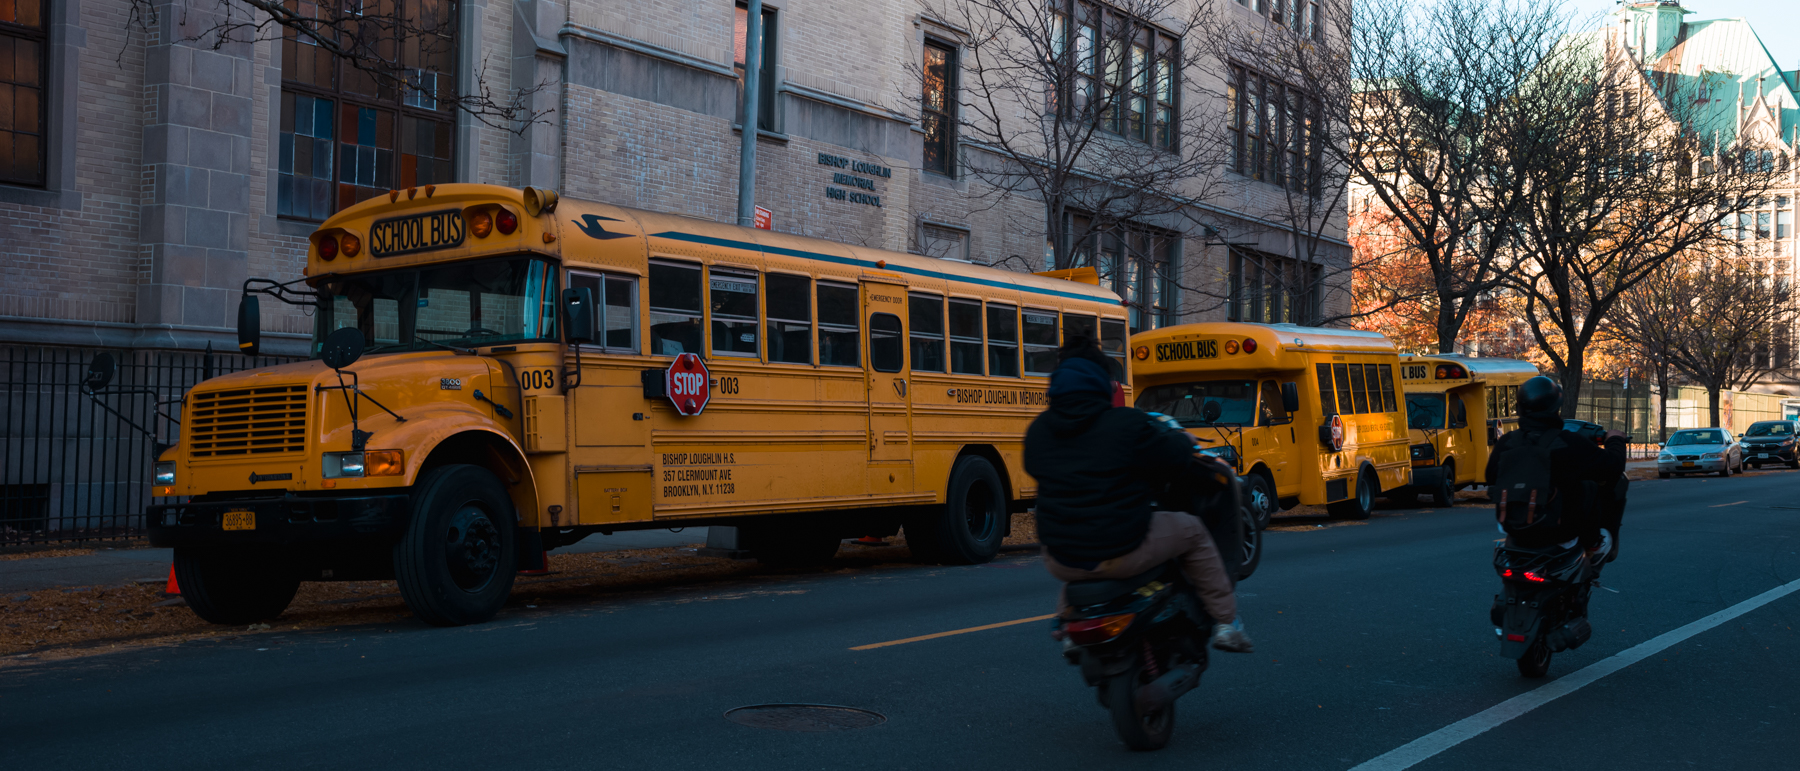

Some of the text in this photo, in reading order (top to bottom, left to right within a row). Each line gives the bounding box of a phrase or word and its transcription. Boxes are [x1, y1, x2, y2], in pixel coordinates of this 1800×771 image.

[818, 153, 891, 178] BISHOP LOUGHLIN
[834, 173, 876, 191] MEMORIAL
[826, 187, 882, 208] HIGH SCHOOL
[374, 212, 460, 253] SCHOOL BUS
[871, 294, 902, 304] EMERGENCY DOOR
[1157, 340, 1216, 361] SCHOOL BUS
[522, 370, 554, 390] 003
[1409, 365, 1426, 379] BUS
[673, 372, 704, 395] STOP
[720, 377, 739, 394] 003
[957, 388, 982, 403] BISHOP
[984, 390, 1017, 405] LOUGHLIN
[663, 453, 736, 465] BISHOP LOUGHLIN H.S.
[663, 470, 731, 481] 357 CLERMOUNT AVE
[664, 483, 735, 497] BROOKLYN, N.Y. 11238
